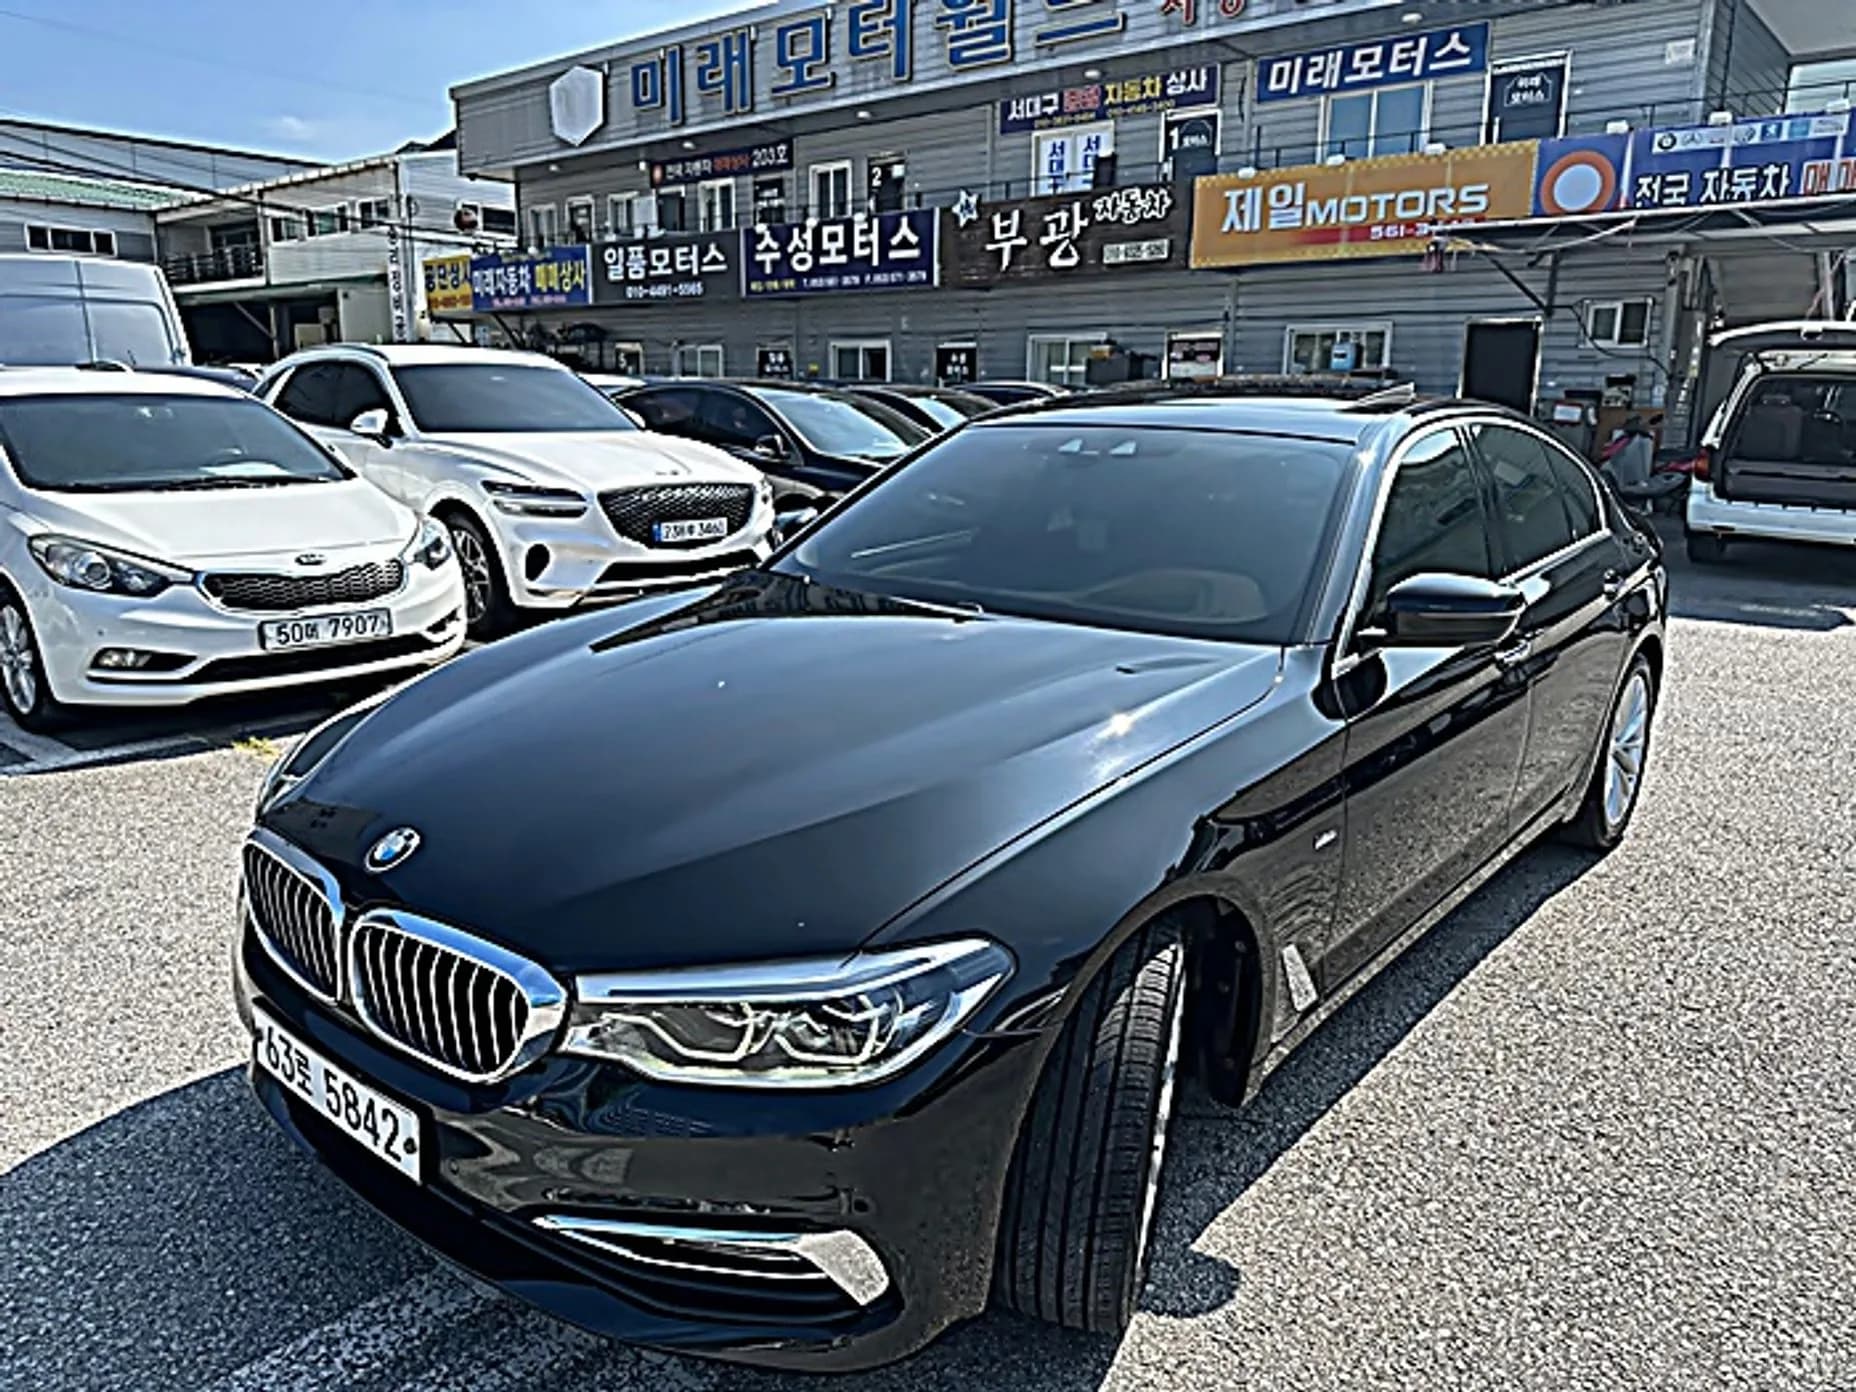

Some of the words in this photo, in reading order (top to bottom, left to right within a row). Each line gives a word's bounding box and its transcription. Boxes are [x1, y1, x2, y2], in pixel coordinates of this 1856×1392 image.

[1267, 31, 1472, 94] 미래모터스
[1007, 93, 1060, 121] 서대구
[1103, 76, 1163, 106] 자동차
[1166, 67, 1208, 97] 상사
[1699, 164, 1790, 204] 자동차
[754, 215, 922, 275] 주성모터스
[985, 201, 1089, 272] 부광
[1092, 187, 1173, 224] 자동차
[604, 242, 728, 282] 일품모터스
[328, 614, 380, 638] 7907
[323, 1067, 403, 1163] 5842
